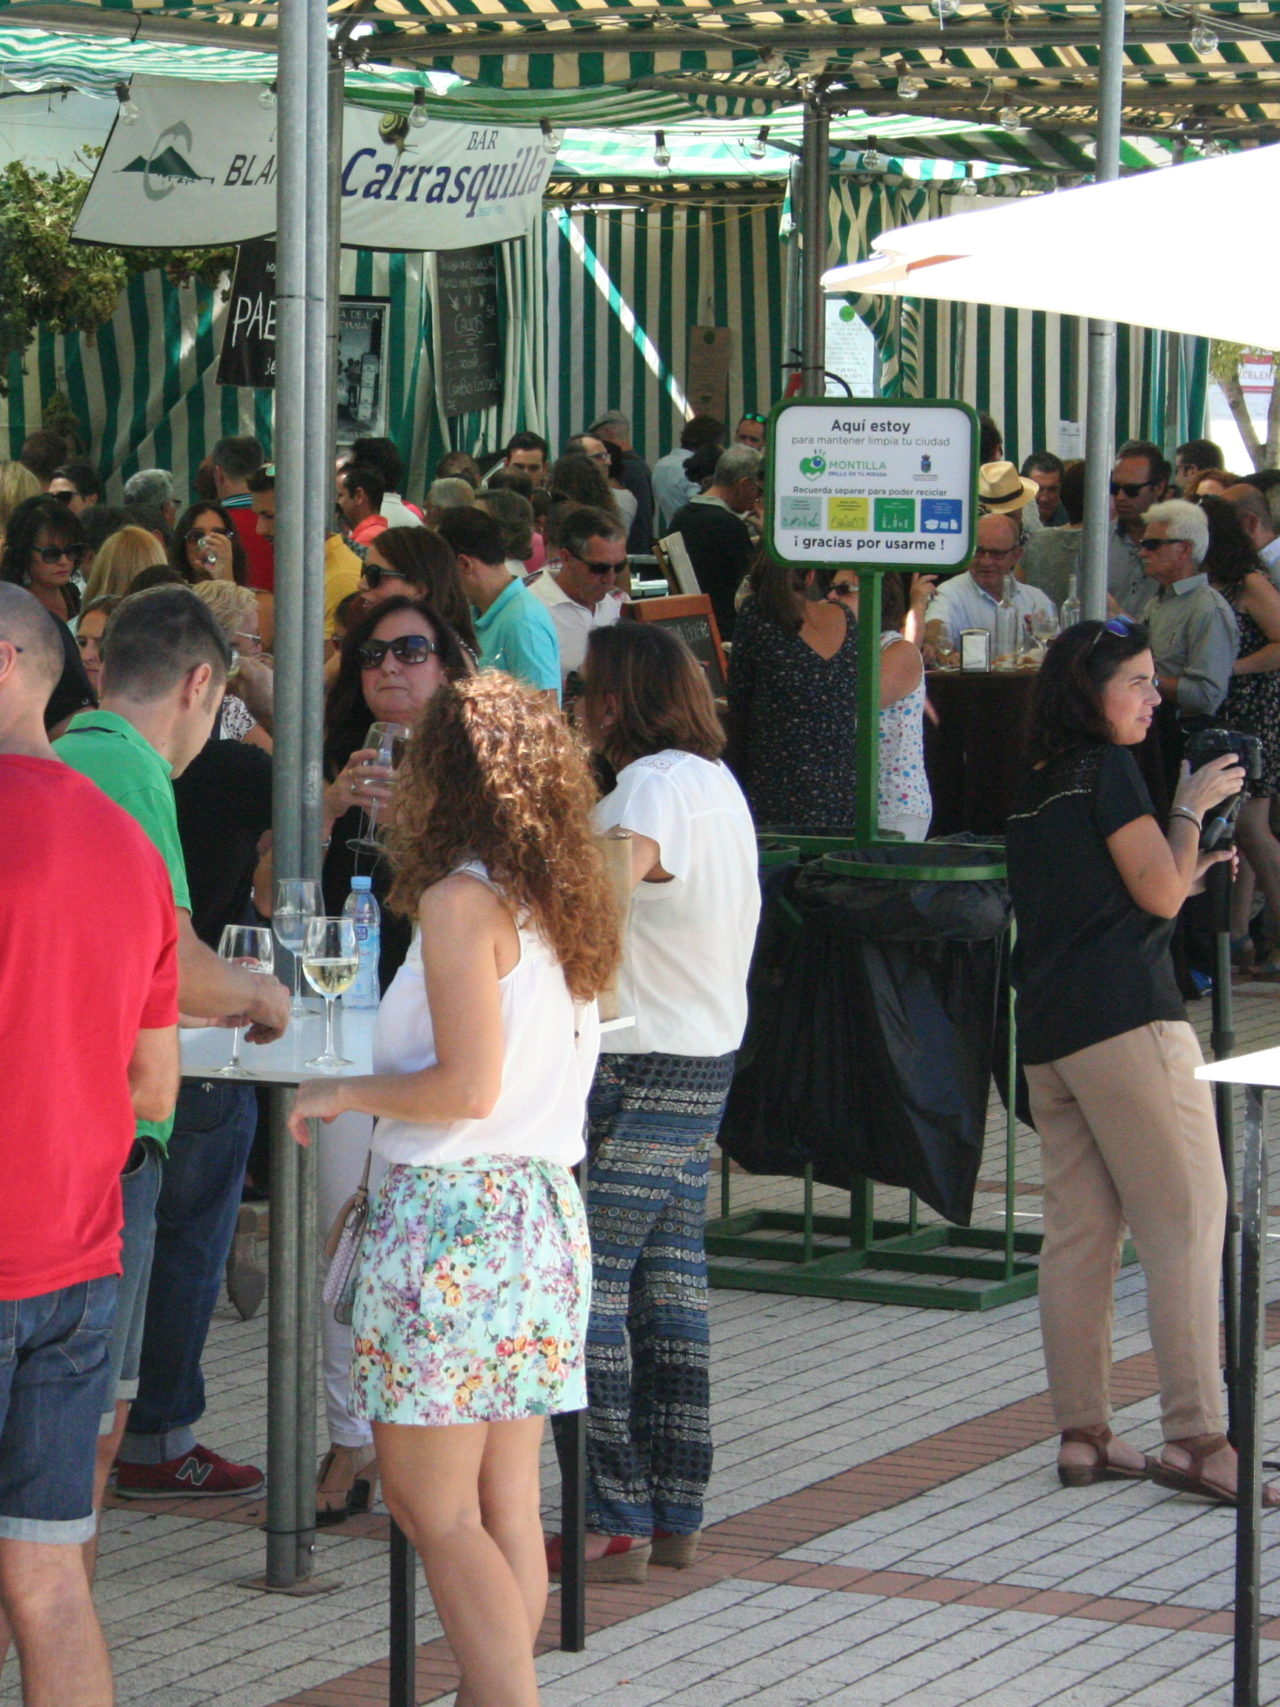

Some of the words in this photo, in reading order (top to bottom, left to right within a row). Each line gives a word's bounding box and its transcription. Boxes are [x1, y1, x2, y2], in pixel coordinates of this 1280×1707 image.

[466, 129, 499, 151] BAR
[223, 154, 277, 187] BLA
[341, 146, 548, 218] Carrasquilla
[831, 419, 865, 433] Aquí
[870, 420, 911, 435] estoy
[791, 437, 814, 445] para
[817, 436, 865, 445] mantener
[868, 436, 898, 447] limpia
[902, 437, 912, 446] tu
[915, 437, 950, 446] ciudad
[829, 460, 887, 470] MONTILLA
[793, 486, 832, 495] Recuerda
[834, 488, 865, 496] separar
[888, 488, 913, 497] poder
[802, 536, 852, 550] gracias
[856, 538, 881, 551] por
[885, 540, 936, 550] usarme
[175, 1457, 213, 1486] N
